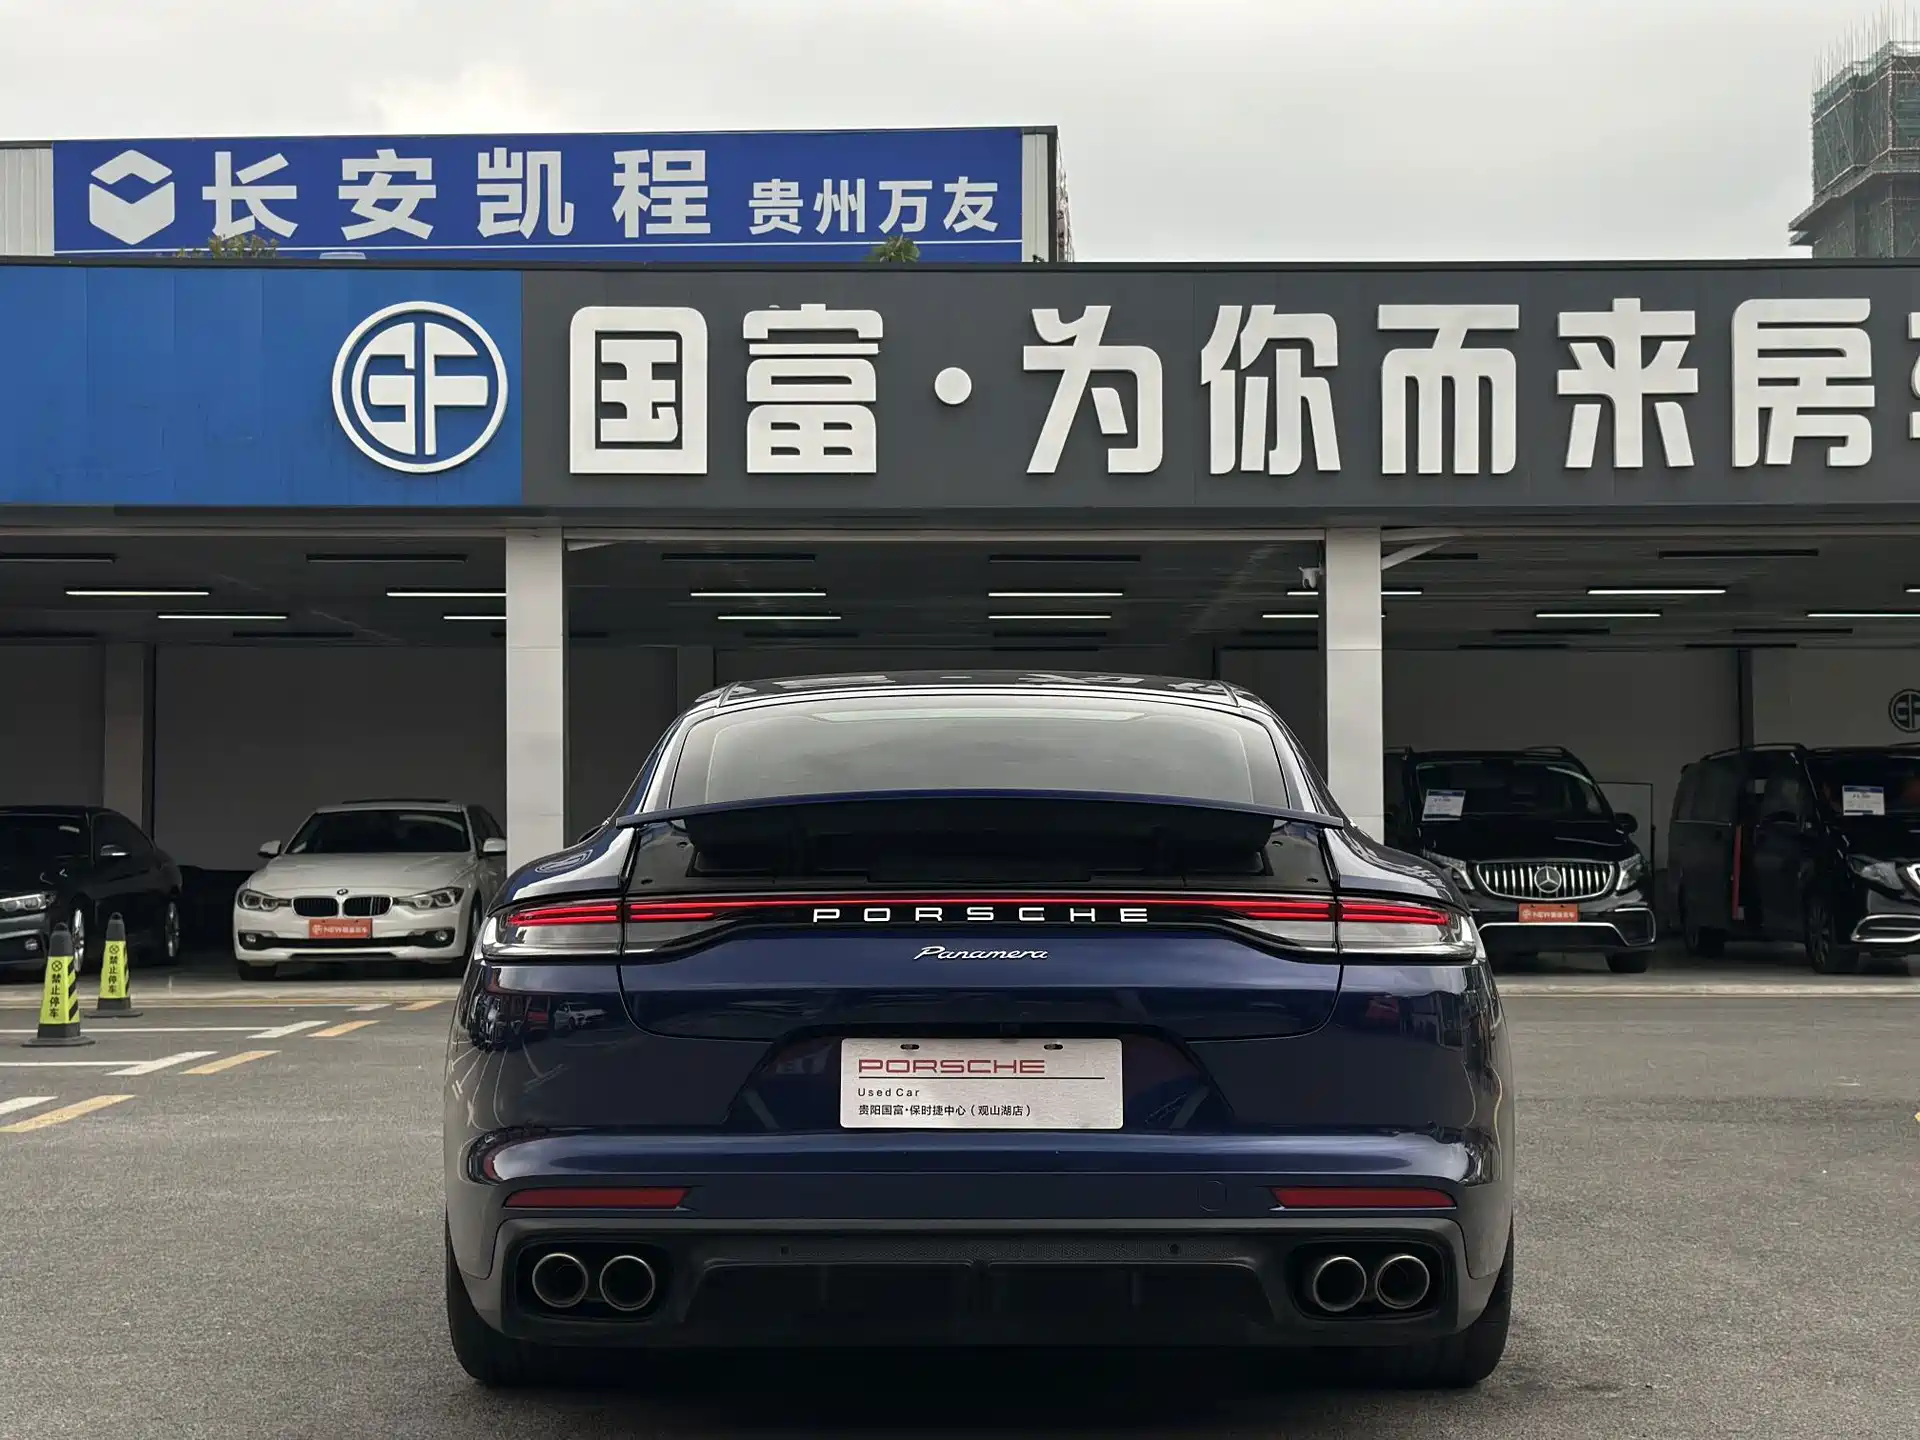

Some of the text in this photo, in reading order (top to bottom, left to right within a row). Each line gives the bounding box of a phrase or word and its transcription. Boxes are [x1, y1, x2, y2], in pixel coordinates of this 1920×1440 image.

[202, 147, 998, 241] 长安凯程 贵州万友
[570, 298, 1920, 475] 国富·为你而来房
[813, 907, 1148, 923] PORSCHE
[914, 945, 1048, 960] Panamera
[107, 956, 118, 995] 禁止停车
[49, 974, 61, 1018] 禁止停车
[859, 1059, 1045, 1074] PORSCHE
[858, 1088, 920, 1097] Used Car
